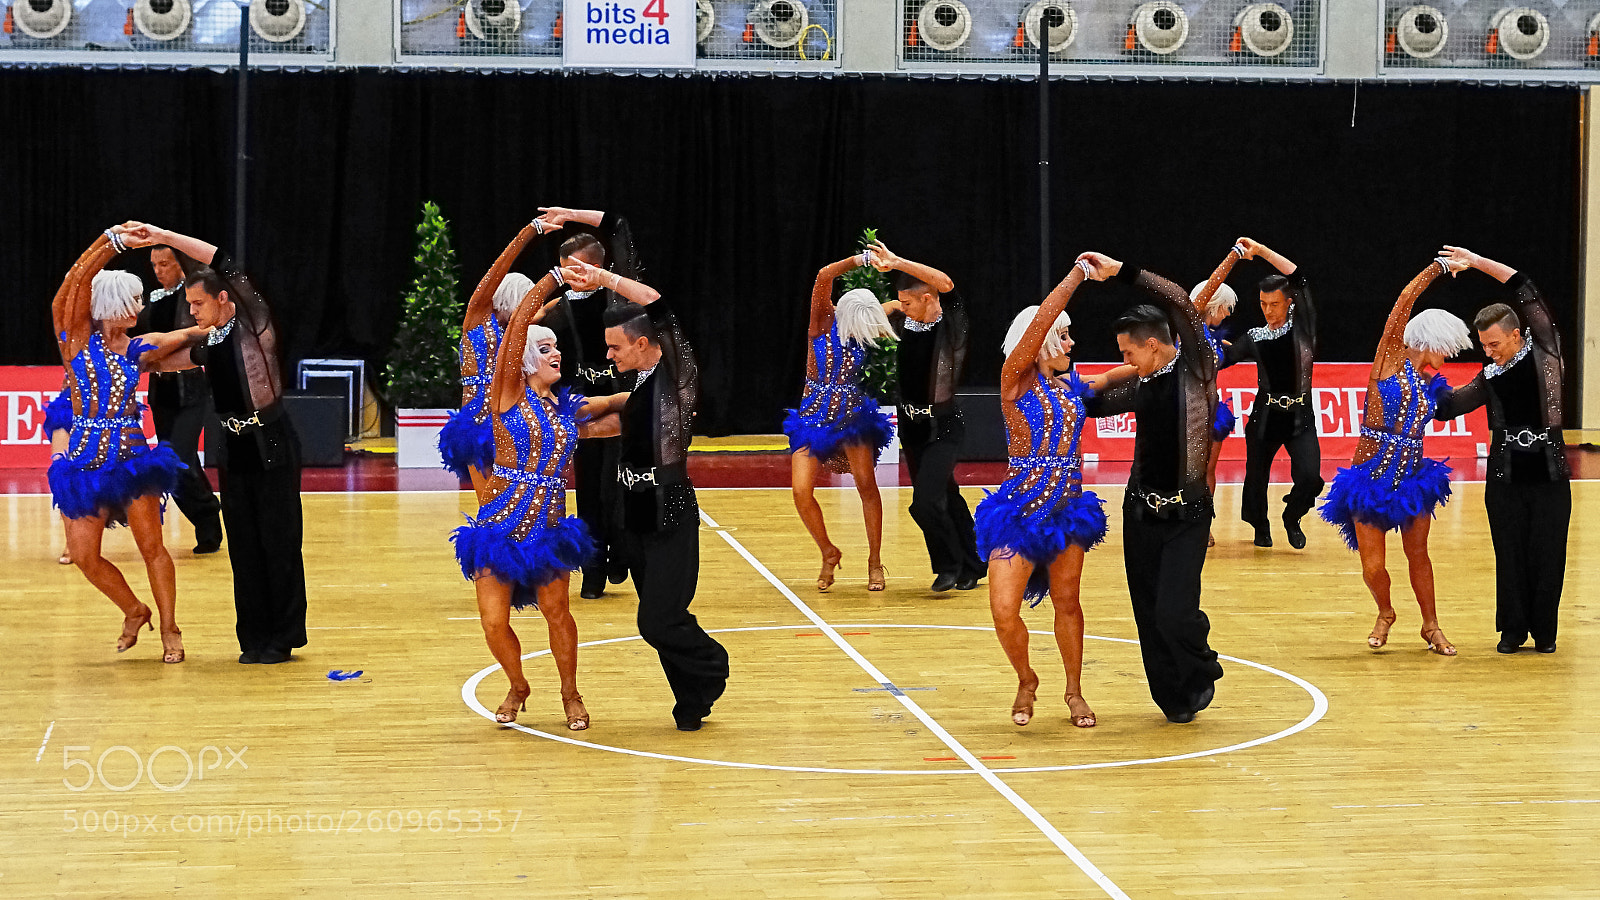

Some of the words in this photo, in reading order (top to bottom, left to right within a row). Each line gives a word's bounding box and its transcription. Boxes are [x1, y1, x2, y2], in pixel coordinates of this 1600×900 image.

[587, 2, 636, 24] bits
[642, 0, 670, 25] 4
[587, 23, 670, 45] media
